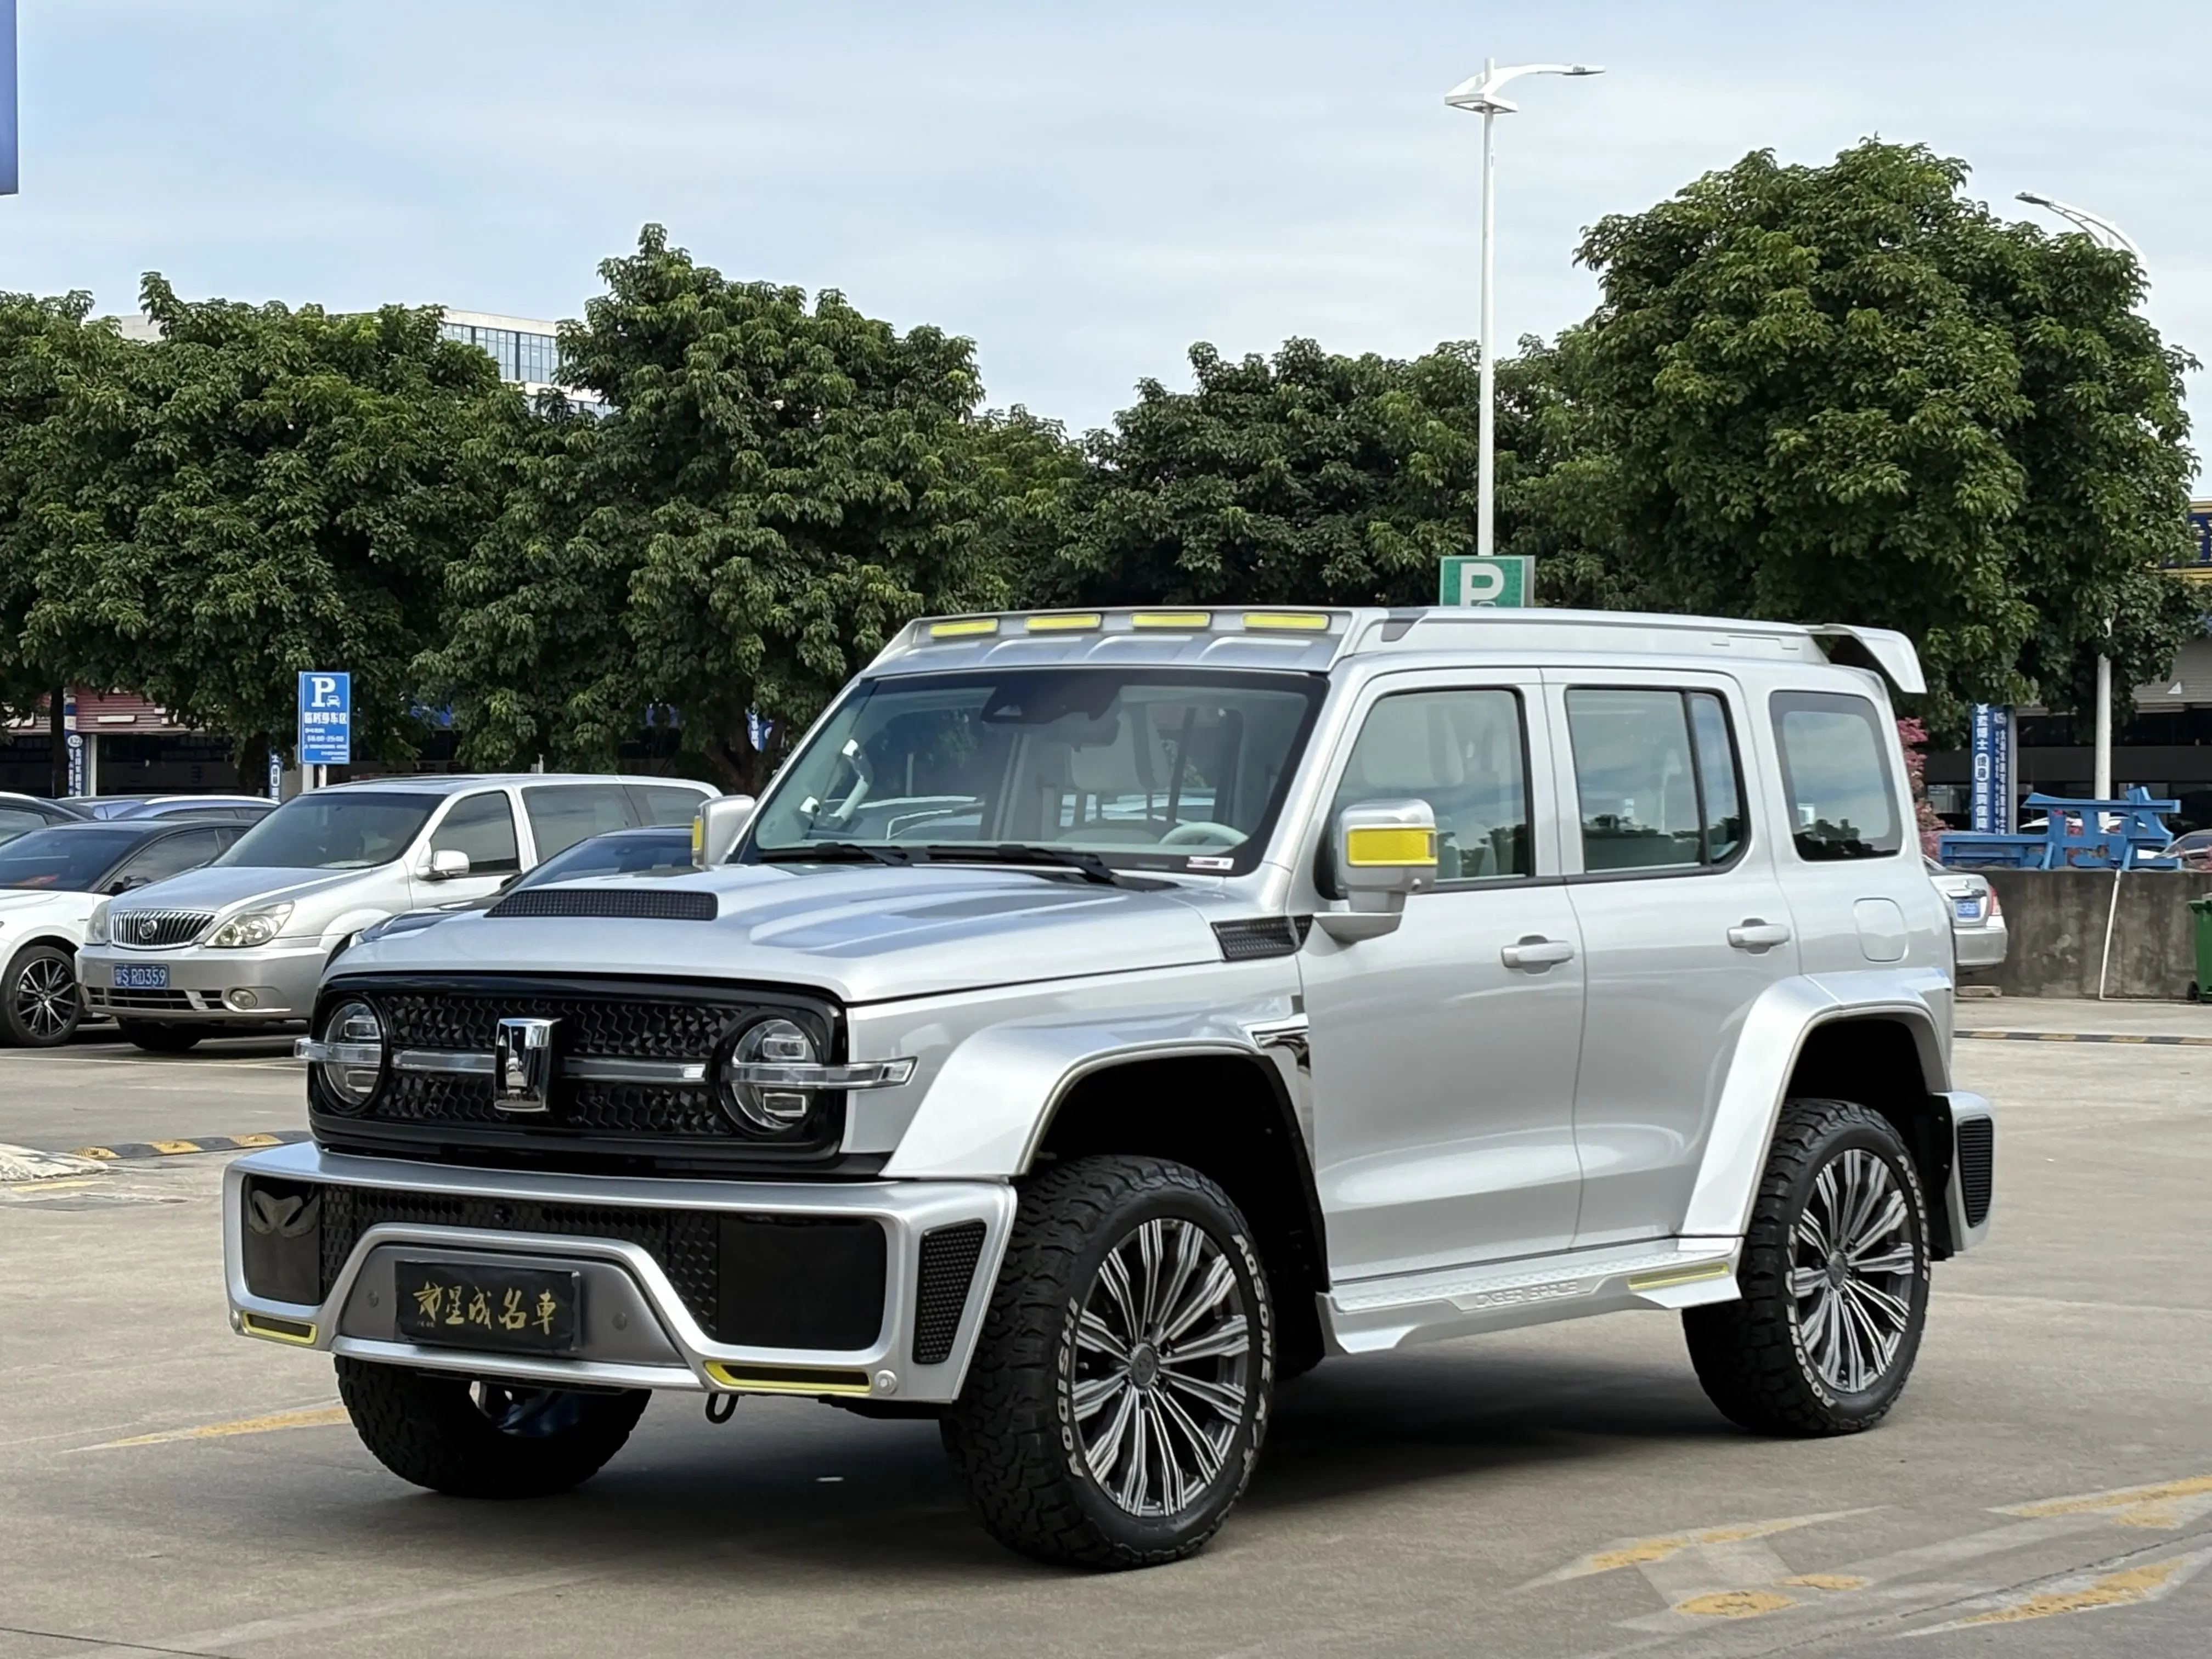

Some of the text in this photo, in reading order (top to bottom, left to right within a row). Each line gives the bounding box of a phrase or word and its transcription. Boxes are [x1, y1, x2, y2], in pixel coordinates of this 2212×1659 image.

[1460, 563, 1504, 606] P
[311, 677, 336, 707] P
[1232, 1234, 1272, 1383] AOSONE
[1057, 1297, 1085, 1477] AOQISHI
